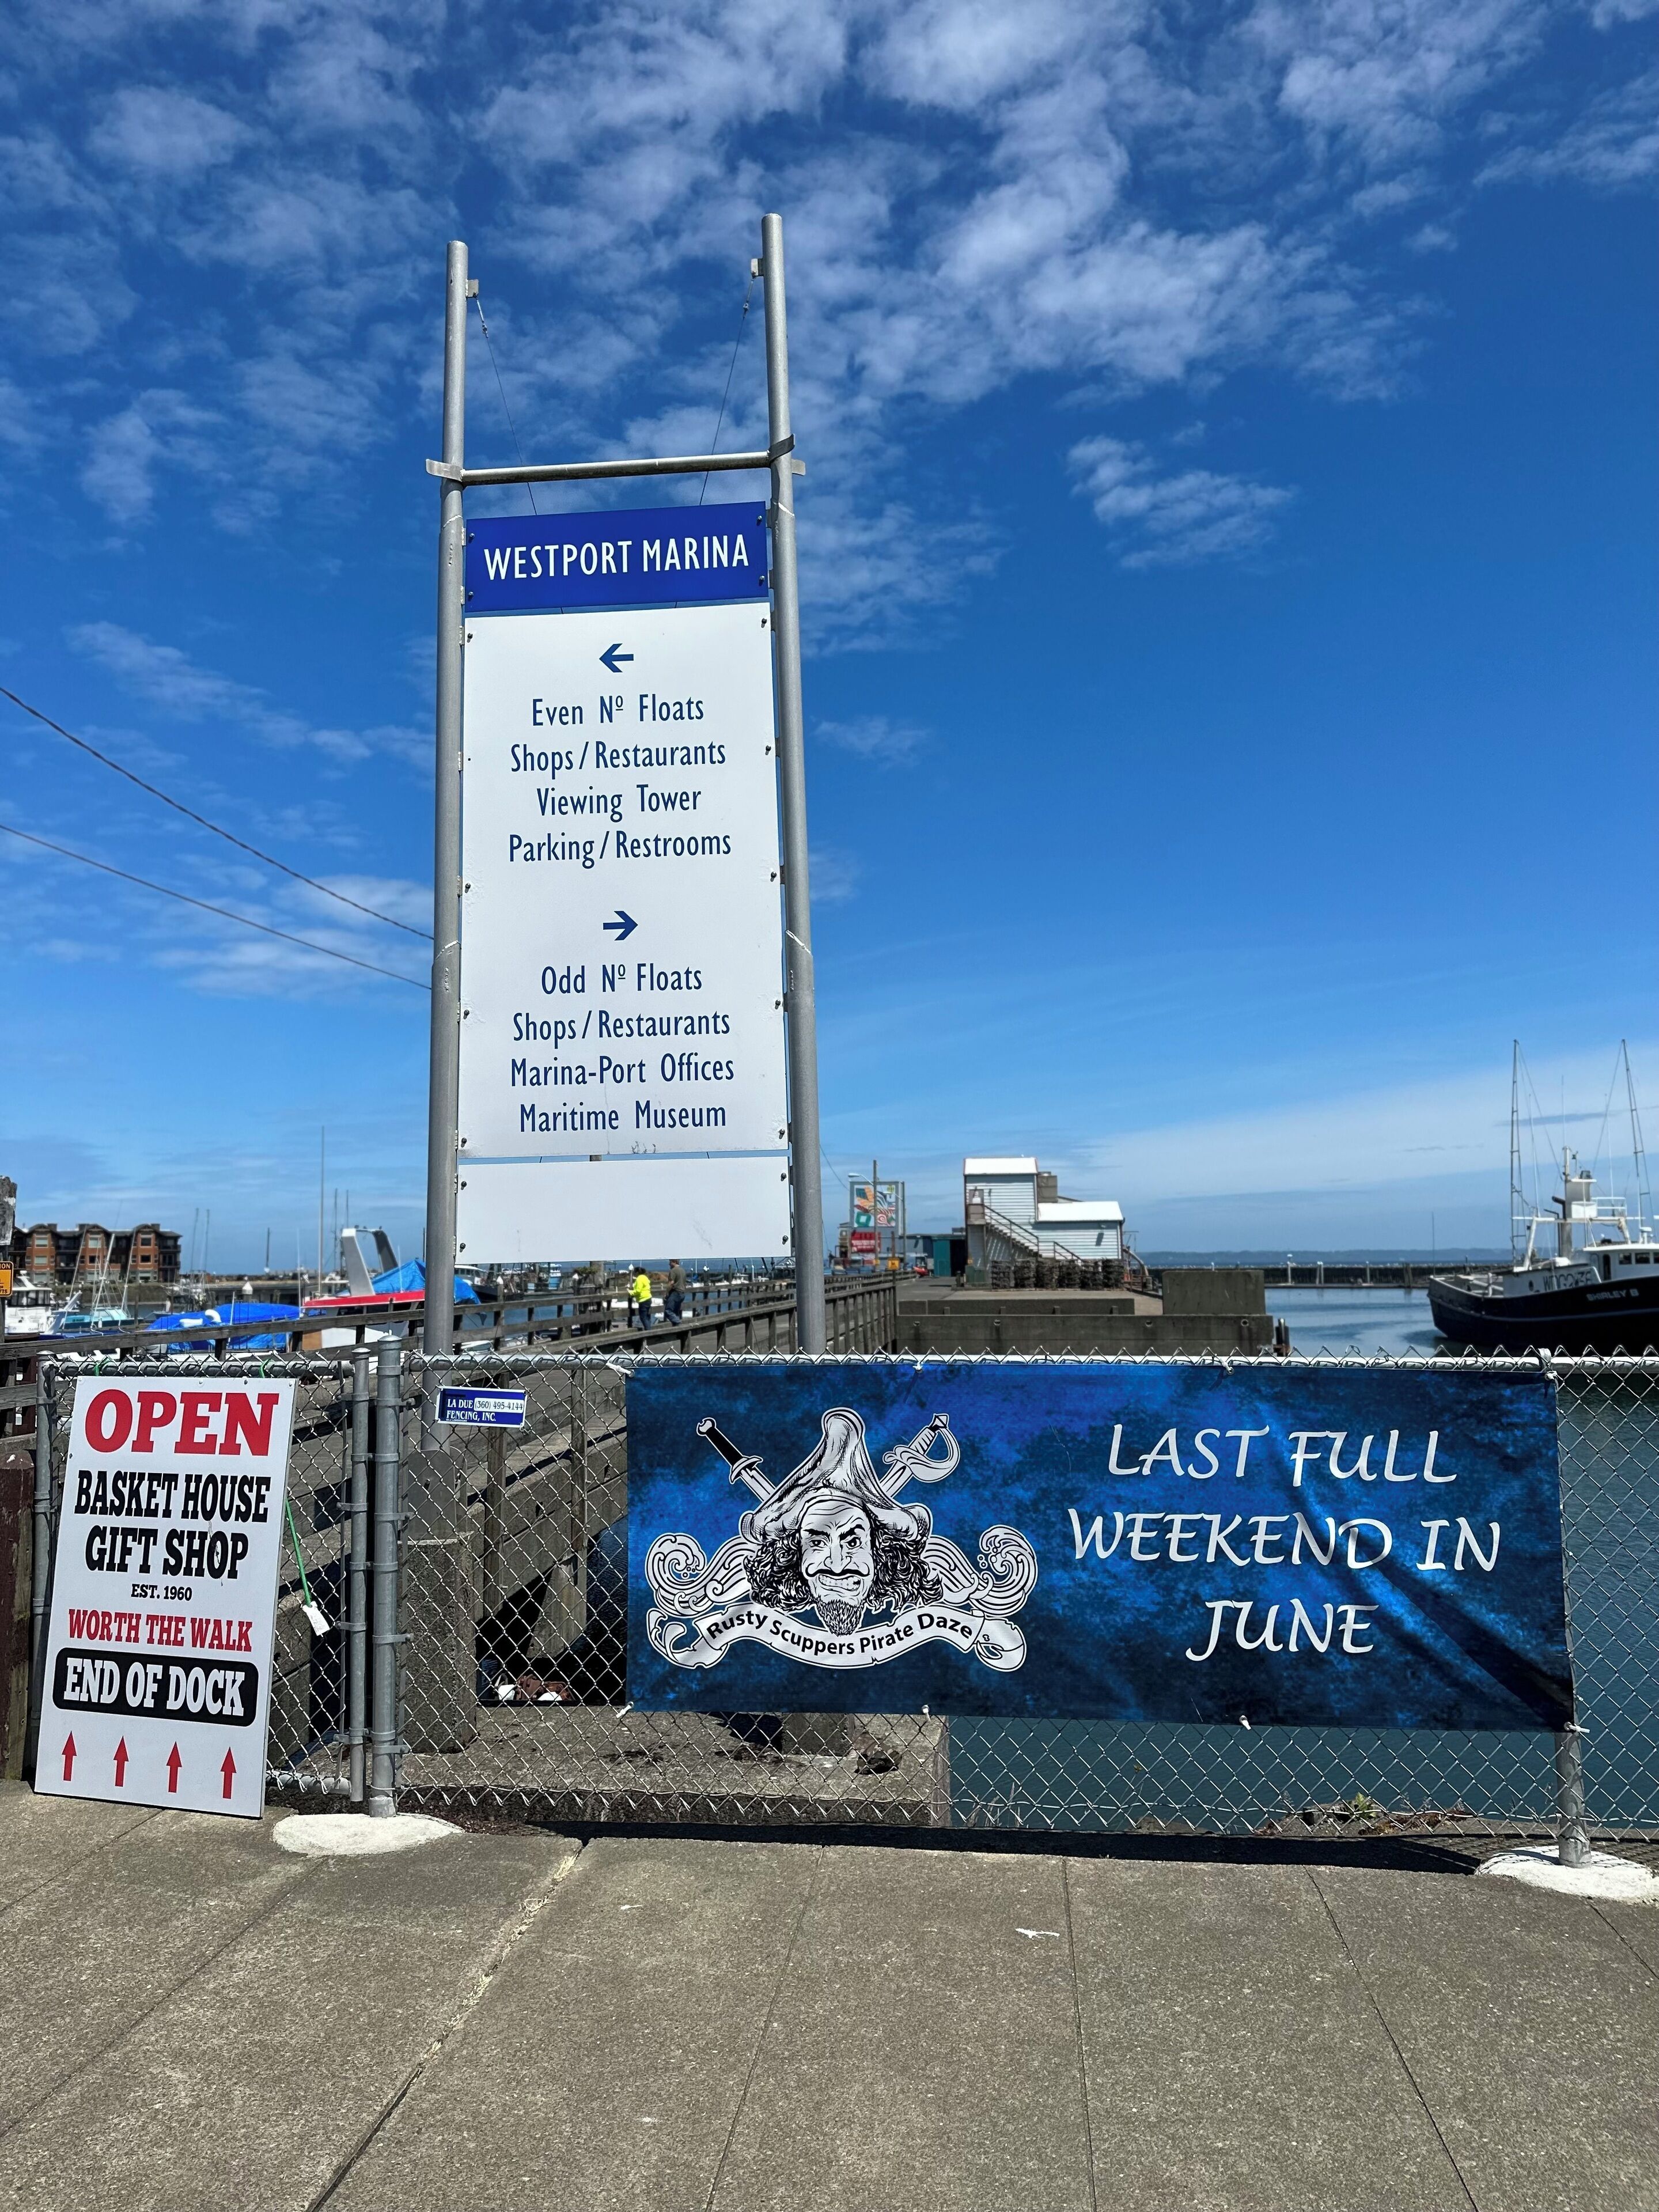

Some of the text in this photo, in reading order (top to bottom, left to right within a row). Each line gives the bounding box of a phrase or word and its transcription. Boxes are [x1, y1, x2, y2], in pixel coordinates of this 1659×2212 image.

[483, 534, 749, 580] WESTPORT MARINA
[532, 698, 583, 726] Even
[639, 694, 704, 722] Floats
[536, 784, 702, 823] Viewing Tower
[541, 965, 585, 995] Odd
[637, 963, 702, 991] Floats
[512, 1052, 734, 1087] Marina-Port Offices
[520, 1100, 726, 1132] Maritime Museum
[1586, 1290, 1626, 1301] SHIRLEY
[85, 1389, 279, 1456] OPEN
[446, 1411, 496, 1421] FENCING, INC.
[447, 1399, 473, 1408] LA DUE
[475, 1401, 523, 1410] (360) 495-4144
[1108, 1424, 1457, 1487] LAST FULL
[74, 1469, 271, 1523] BASKET HOUSE
[85, 1525, 249, 1580] GIFT SHOP
[1067, 1508, 1500, 1571] WEEKEND IN
[131, 1583, 192, 1601] EST. 1960
[69, 1609, 252, 1652] WORTH THE WALK
[706, 1610, 972, 1656] Rusty Scuppers Pirate Daze
[1185, 1598, 1379, 1661] JUNE
[63, 1657, 245, 1717] END OF DOCK
